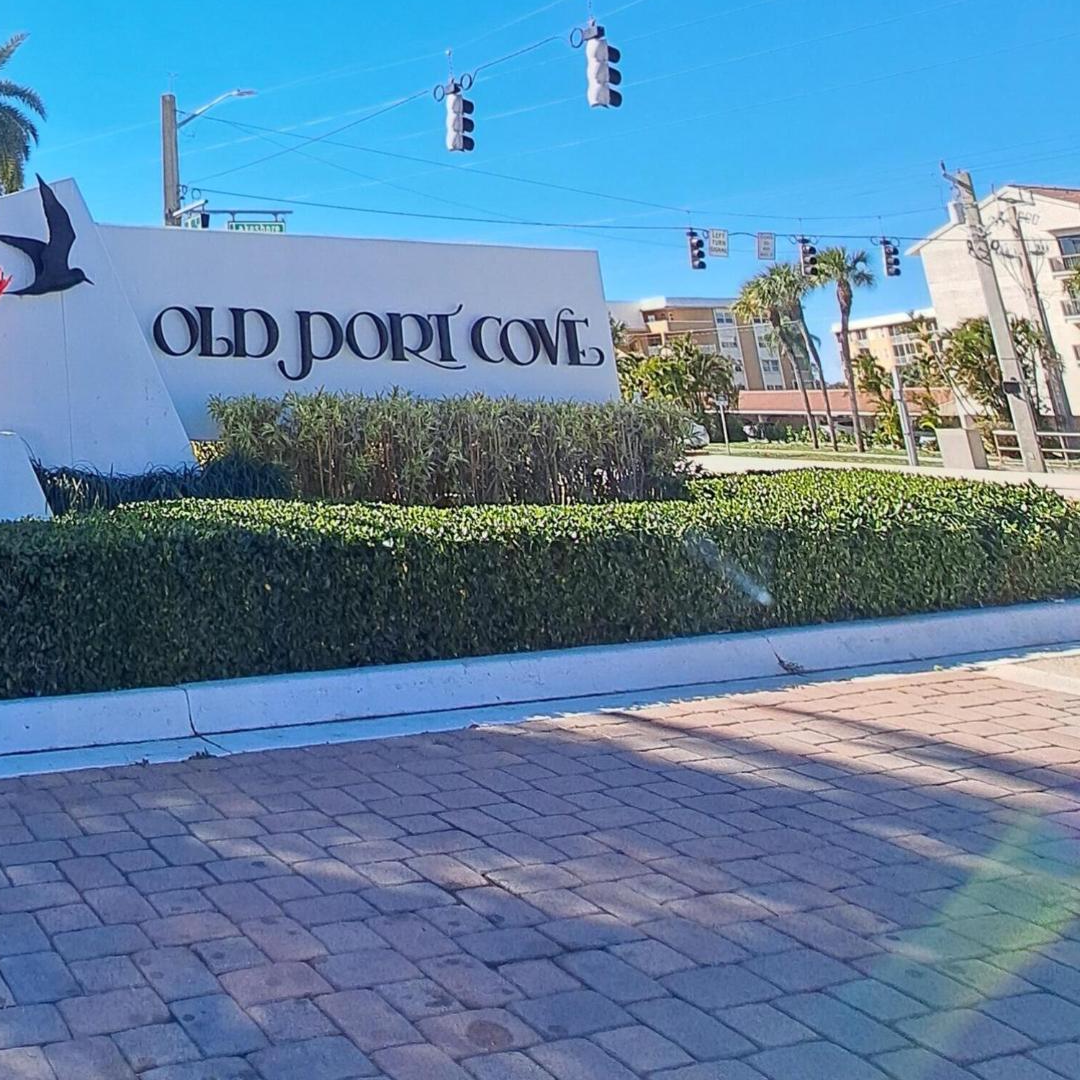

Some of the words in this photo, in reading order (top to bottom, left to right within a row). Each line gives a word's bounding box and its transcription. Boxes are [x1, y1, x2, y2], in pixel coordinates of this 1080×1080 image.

[153, 306, 279, 358] OLD
[278, 304, 466, 381] PORT
[470, 308, 605, 366] COVE
